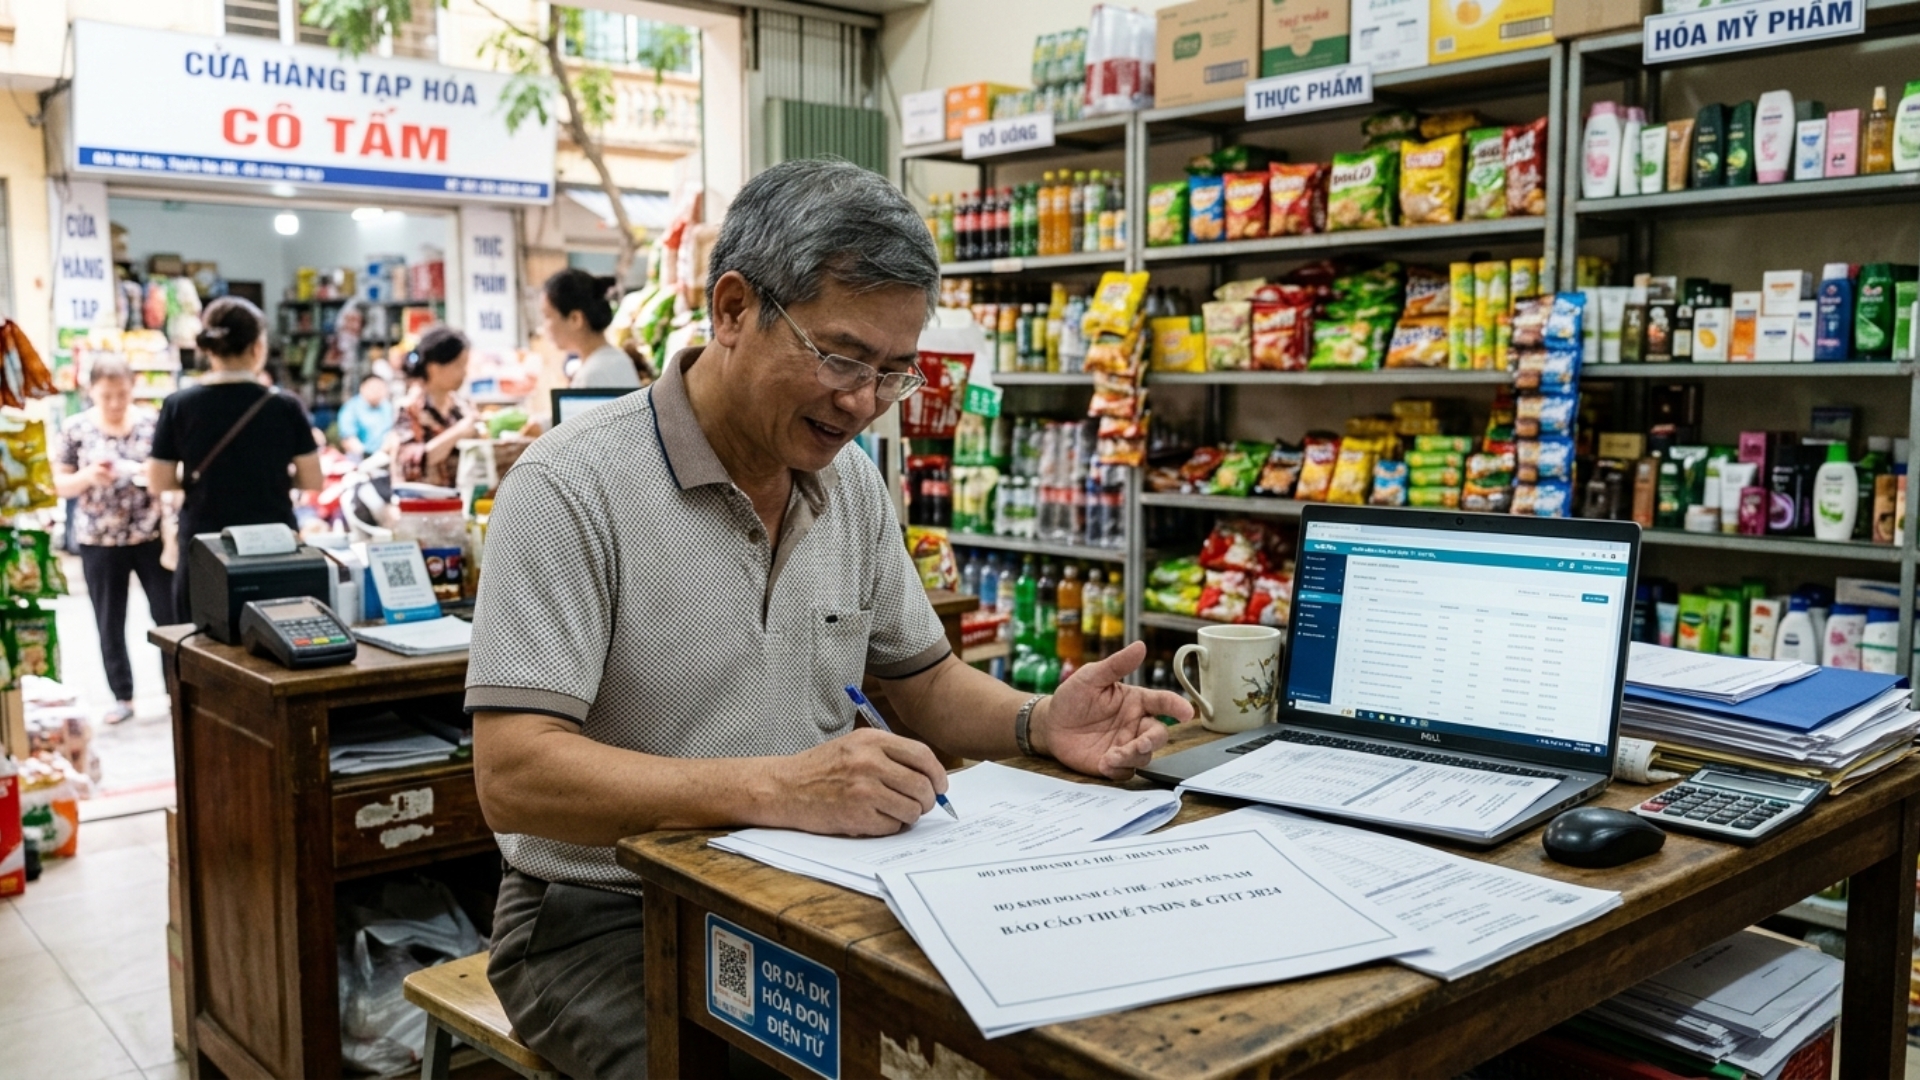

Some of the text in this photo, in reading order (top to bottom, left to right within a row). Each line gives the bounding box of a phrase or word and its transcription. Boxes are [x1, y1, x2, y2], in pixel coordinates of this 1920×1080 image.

[1655, 20, 1707, 51] HÓA
[1717, 10, 1758, 42] MỸ
[186, 43, 478, 106] CỬA HÀNG TẠP HÓA
[1255, 86, 1300, 110] THỰC
[223, 103, 448, 161] CÔ TẤM
[1000, 920, 1040, 936] BÁO
[1044, 916, 1082, 929] CÁO
[1136, 900, 1186, 915] TNDN
[1190, 898, 1204, 908] &
[762, 960, 782, 983] QR
[762, 986, 792, 1015] HÓA
[767, 1015, 800, 1047] ĐIỆN
